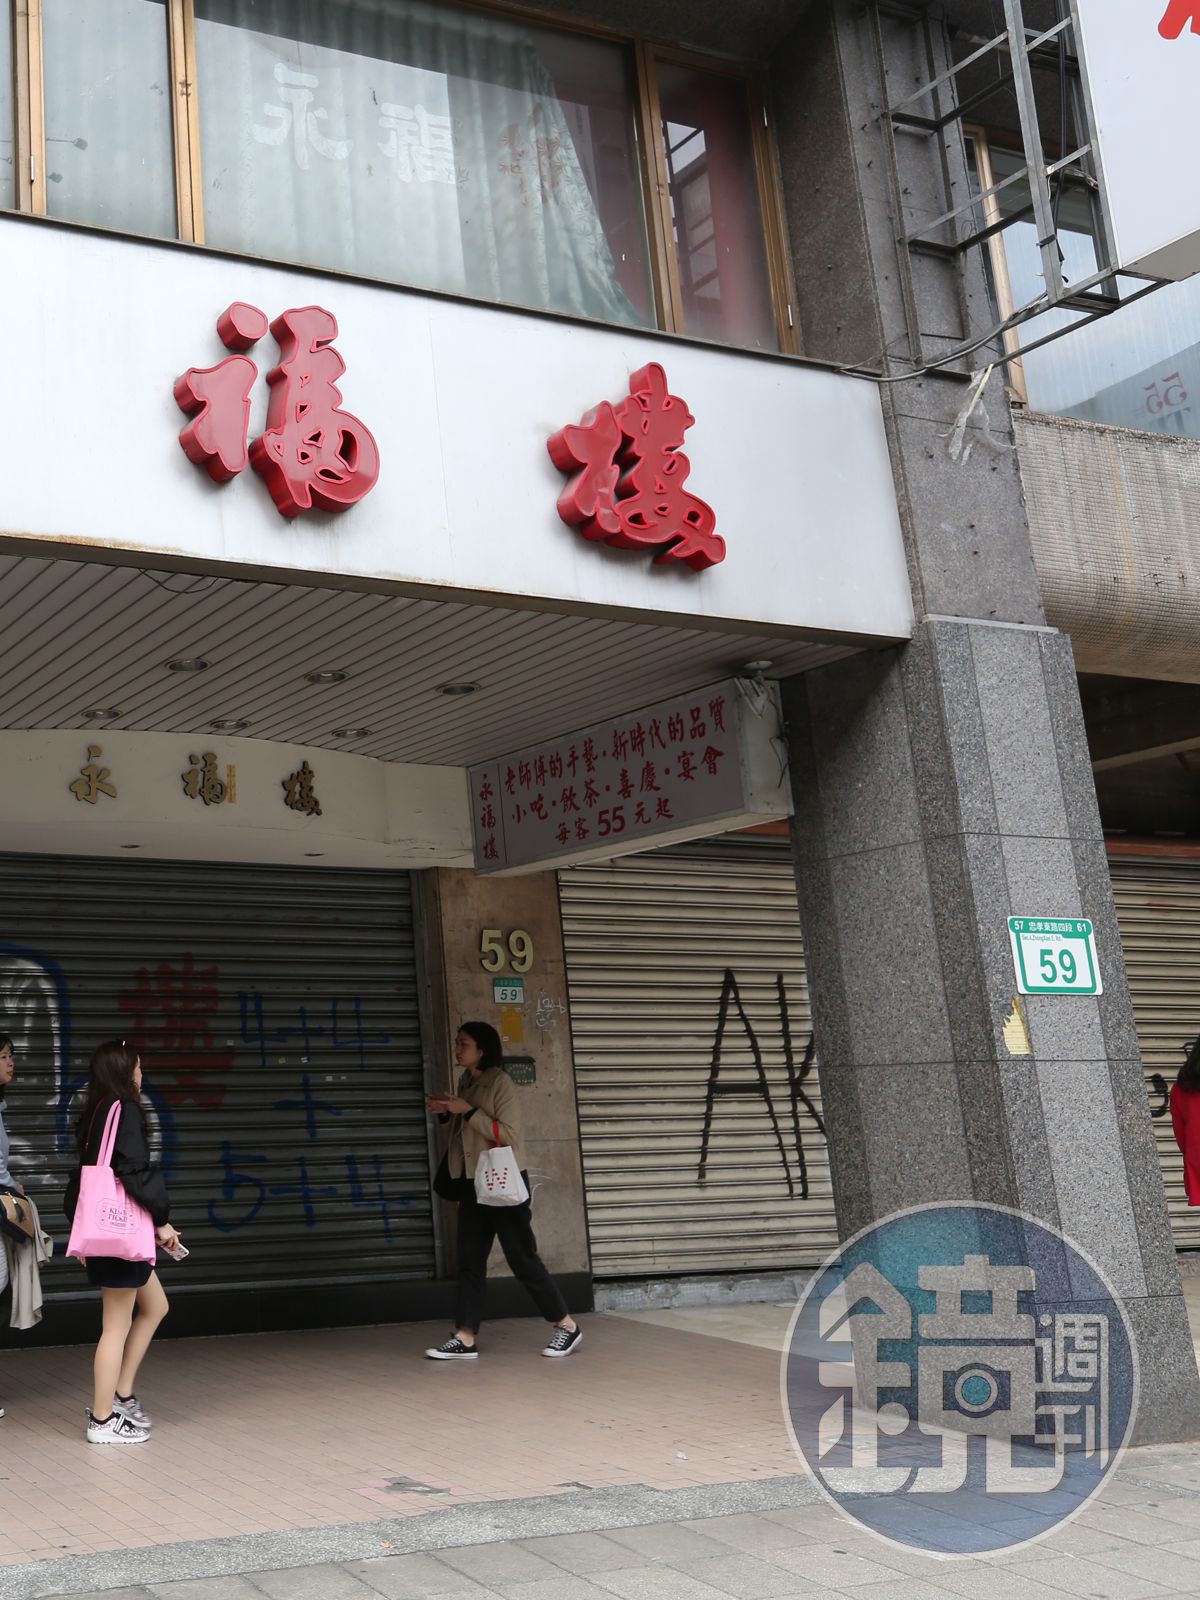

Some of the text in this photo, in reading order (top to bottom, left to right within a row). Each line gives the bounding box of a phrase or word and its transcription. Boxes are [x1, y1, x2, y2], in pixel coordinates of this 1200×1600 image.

[68, 744, 323, 816] 永福樓
[1014, 920, 1024, 930] 57
[1028, 921, 1073, 932] 忠孝東路四段
[1076, 922, 1087, 932] 61
[480, 929, 534, 973] 59
[1040, 949, 1077, 984] 59
[500, 989, 517, 1000] 59
